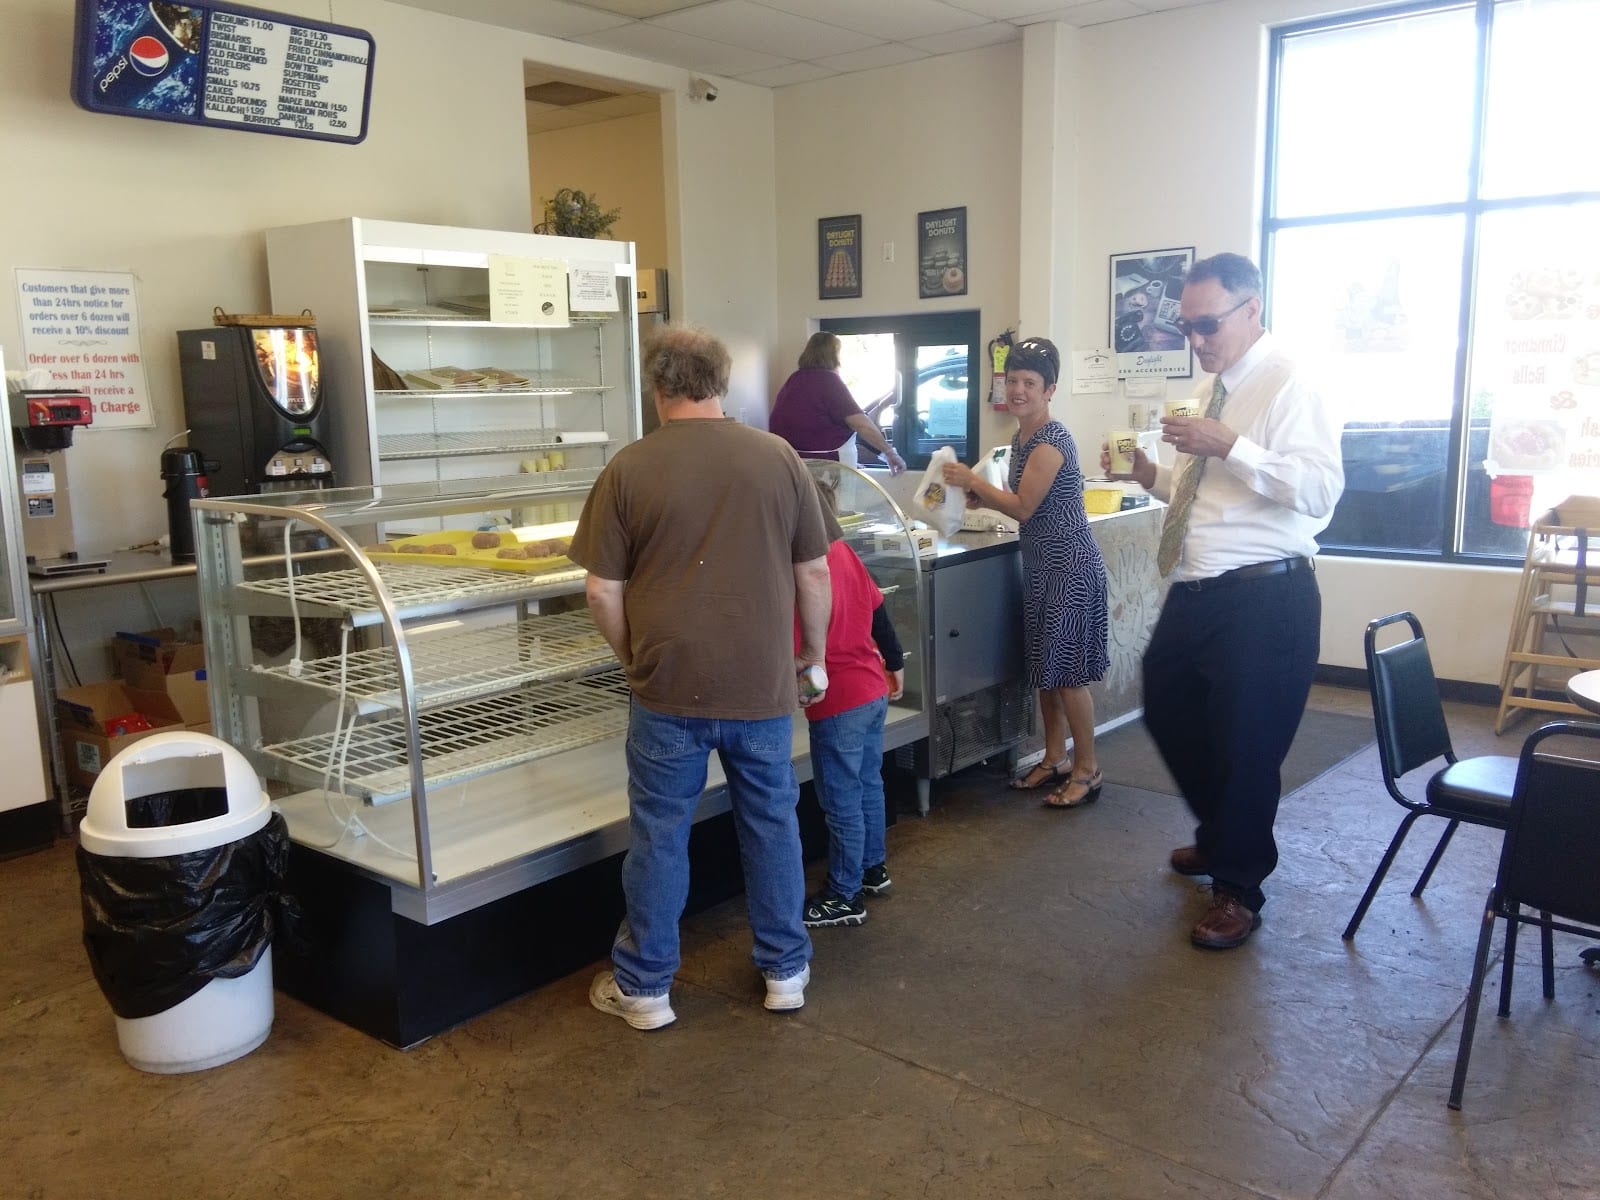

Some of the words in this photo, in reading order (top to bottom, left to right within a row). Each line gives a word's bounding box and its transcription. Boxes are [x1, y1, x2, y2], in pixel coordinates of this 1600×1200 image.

[212, 22, 237, 33] TWIST
[252, 20, 273, 30] $1.00
[211, 31, 251, 44] BISMARKS
[290, 27, 308, 37] BIGS
[209, 40, 237, 51] SMALL
[289, 36, 303, 45] BIG
[288, 44, 310, 55] FRIED
[209, 48, 224, 58] OLD
[227, 51, 267, 64] FASHIONED
[286, 53, 306, 62] BEAR
[308, 56, 333, 68] CLAWS
[208, 57, 251, 70] CRUELERS
[285, 61, 302, 70] BOW
[304, 64, 318, 73] TIES
[100, 56, 128, 92] pepsi
[208, 66, 229, 76] BARS
[283, 70, 328, 83] SUPERMANS
[207, 77, 238, 87] SMALLS
[241, 81, 260, 91] $0.75
[283, 78, 320, 90] ROSETTES
[206, 85, 233, 95] CAKES
[282, 86, 317, 98] FRITTERS
[206, 94, 235, 104] RAISED
[237, 97, 267, 107] ROUNDS
[278, 96, 303, 106] MAPLE
[305, 100, 328, 109] BACON
[277, 104, 315, 116] CINNAMON
[244, 115, 280, 126] BURRITOS
[279, 113, 308, 122] DANISH
[925, 218, 957, 230] DAYLIGHT
[826, 230, 855, 240] DAYLIGHT
[928, 227, 955, 237] DONUTS
[829, 238, 853, 247] DONUTS
[22, 283, 68, 293] Customers
[70, 284, 87, 294] that
[90, 285, 106, 296] give
[109, 287, 130, 295] more
[33, 298, 52, 307] than
[56, 298, 81, 307] 24hrs
[83, 299, 109, 308] notice
[111, 299, 123, 308] for
[30, 312, 58, 321] orders
[60, 313, 78, 321] over
[81, 312, 88, 321] 6
[90, 312, 114, 321] dozen
[116, 312, 130, 322] will
[32, 326, 63, 334] receive
[75, 326, 92, 335] 10%
[94, 326, 129, 335] discount
[29, 353, 56, 364] Order
[60, 355, 80, 363] over
[83, 353, 90, 363] 6
[92, 353, 118, 363] dozen
[121, 353, 139, 363] with
[1136, 355, 1162, 368] Daylight
[49, 370, 68, 379] ess
[71, 370, 91, 379] than
[95, 369, 106, 379] 24
[110, 370, 124, 379] hrs
[94, 385, 125, 394] receive
[101, 402, 140, 414] Charge
